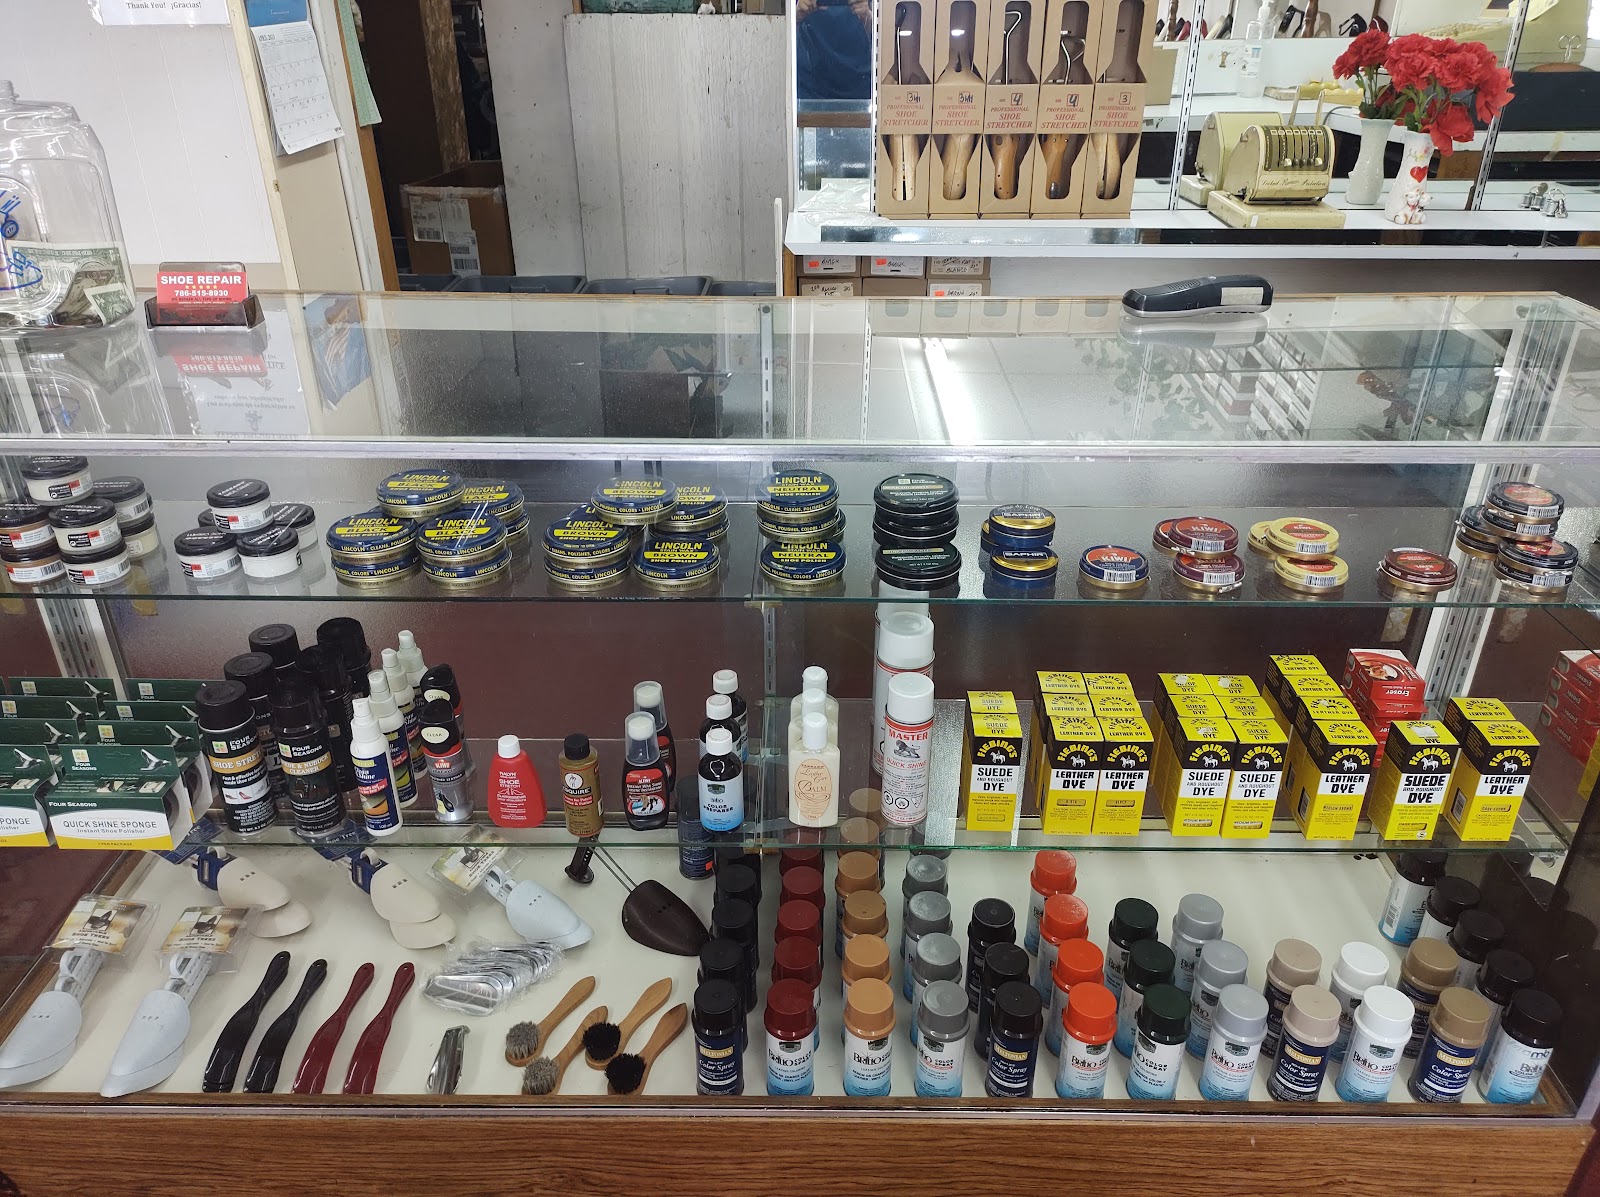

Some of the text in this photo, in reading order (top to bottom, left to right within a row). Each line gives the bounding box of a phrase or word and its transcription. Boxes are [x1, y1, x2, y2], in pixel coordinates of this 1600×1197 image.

[151, 1, 166, 9] You!
[171, 1, 202, 10] ¡Gracias!
[1122, 95, 1128, 103] 3
[986, 121, 1032, 129] STRETCHER
[161, 275, 242, 285] SHOE REPAIR
[402, 474, 450, 482] LINCOLN
[775, 476, 822, 484] LINCOLN
[614, 480, 662, 488] LINCOLN
[348, 518, 400, 526] LINCOLN
[436, 518, 487, 528] LINCOLN
[654, 542, 703, 550] LINCOLN
[780, 542, 828, 550] LINCOLN
[1003, 551, 1048, 559] SAPHIR
[888, 728, 928, 741] MASTER
[229, 735, 250, 747] FOUR
[293, 745, 323, 757] SEASONS
[976, 739, 1018, 758] FIEBING'S
[1057, 743, 1098, 762] FIEBING'S
[1106, 744, 1148, 763] FIEBING'S
[1189, 744, 1231, 762] FIEBING'S
[1241, 746, 1283, 764] FIEBING'S
[1328, 747, 1371, 766] FIEBING'S
[1408, 747, 1451, 766] FIEBING'S
[1488, 748, 1531, 767] FIEBING'S
[213, 761, 234, 770] SHOE
[887, 757, 927, 769] QUICK SHINE
[289, 766, 320, 775] CLEANER
[977, 767, 1013, 777] SUEDE
[1055, 770, 1095, 779] LEATHER
[1105, 771, 1144, 780] LEATHER
[1188, 772, 1225, 781] SUEDE
[1239, 773, 1276, 783] SUEDE
[1325, 774, 1365, 783] LEATHER
[1404, 775, 1447, 787] SUEDE
[1484, 777, 1524, 785] LEATHER
[983, 783, 1005, 792] DYE
[1062, 780, 1086, 790] DYE
[1111, 780, 1135, 790] DYE
[1330, 783, 1356, 794] DYE
[1489, 785, 1514, 795] DYE
[1192, 787, 1215, 796] DYE
[1243, 789, 1266, 798] DYE
[1407, 792, 1434, 804] DYE
[63, 820, 91, 828] QUICK
[120, 821, 157, 829] SPONGE
[700, 1047, 733, 1058] MELTONIAN
[994, 1044, 1028, 1060] MELTONIAN
[1285, 1046, 1321, 1064] MELTONIAN
[1145, 1057, 1168, 1069] COLOR
[1437, 1050, 1475, 1066] MELTONIAN
[699, 1059, 736, 1071] Color Spray
[990, 1055, 1028, 1074] Color Spray
[1145, 1061, 1168, 1073] SPRAY
[1280, 1057, 1319, 1078] Color Spray
[1431, 1063, 1471, 1080] Color Spray
